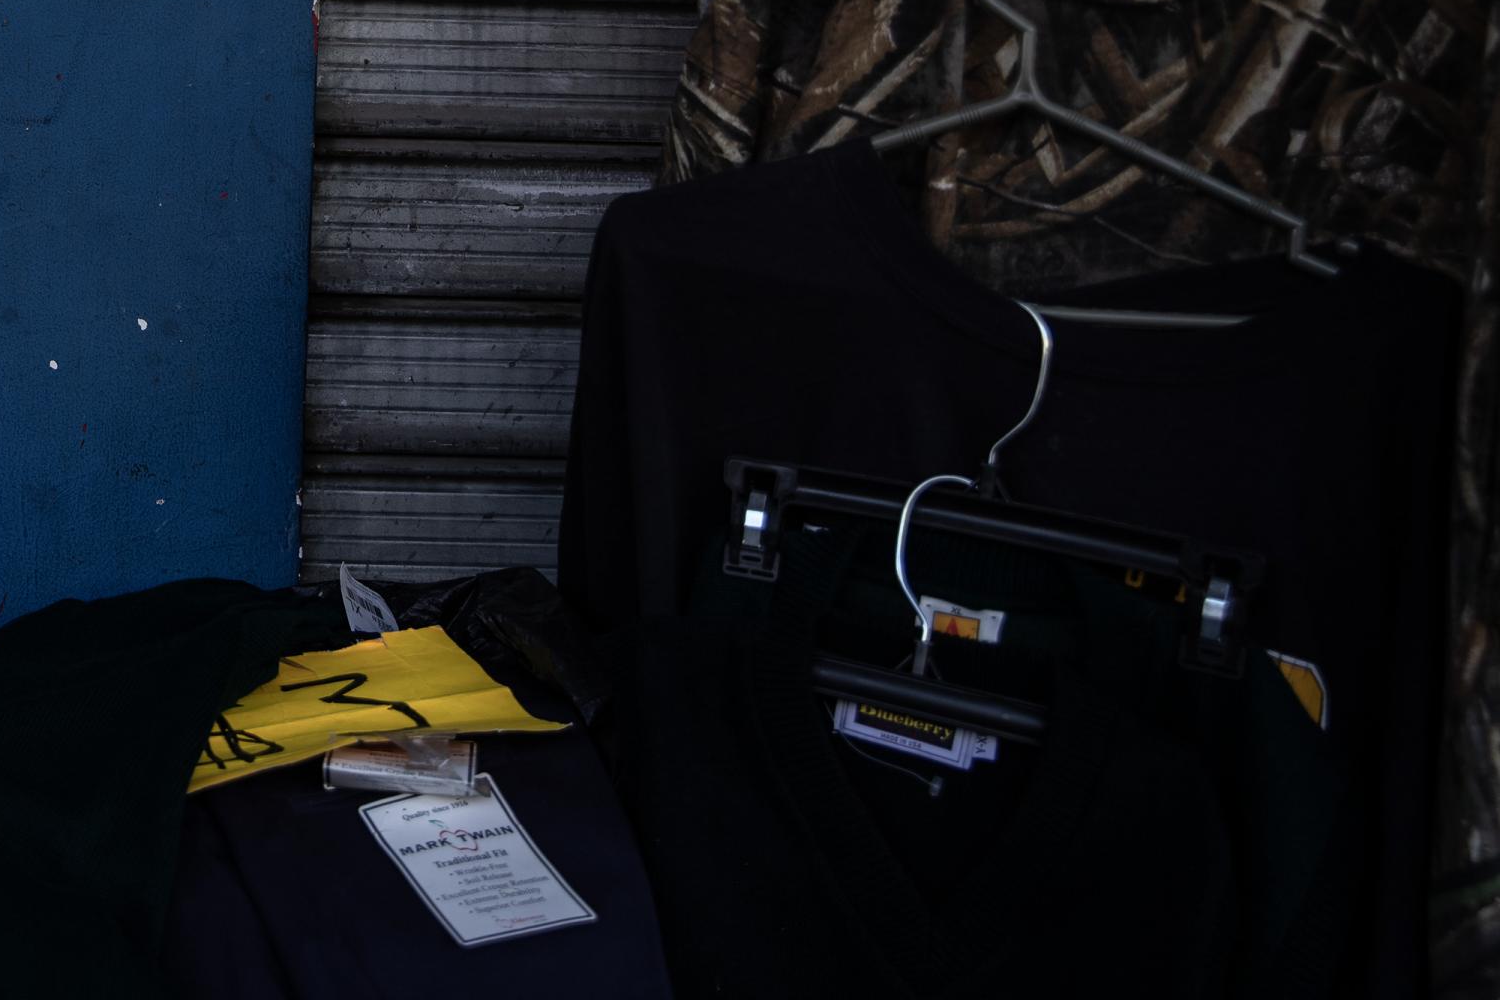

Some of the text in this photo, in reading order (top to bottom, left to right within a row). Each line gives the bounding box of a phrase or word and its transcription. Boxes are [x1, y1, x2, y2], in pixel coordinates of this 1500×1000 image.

[401, 808, 430, 822] Quality
[398, 824, 514, 857] MARK TWAIN
[433, 848, 509, 869] Traditional Fit
